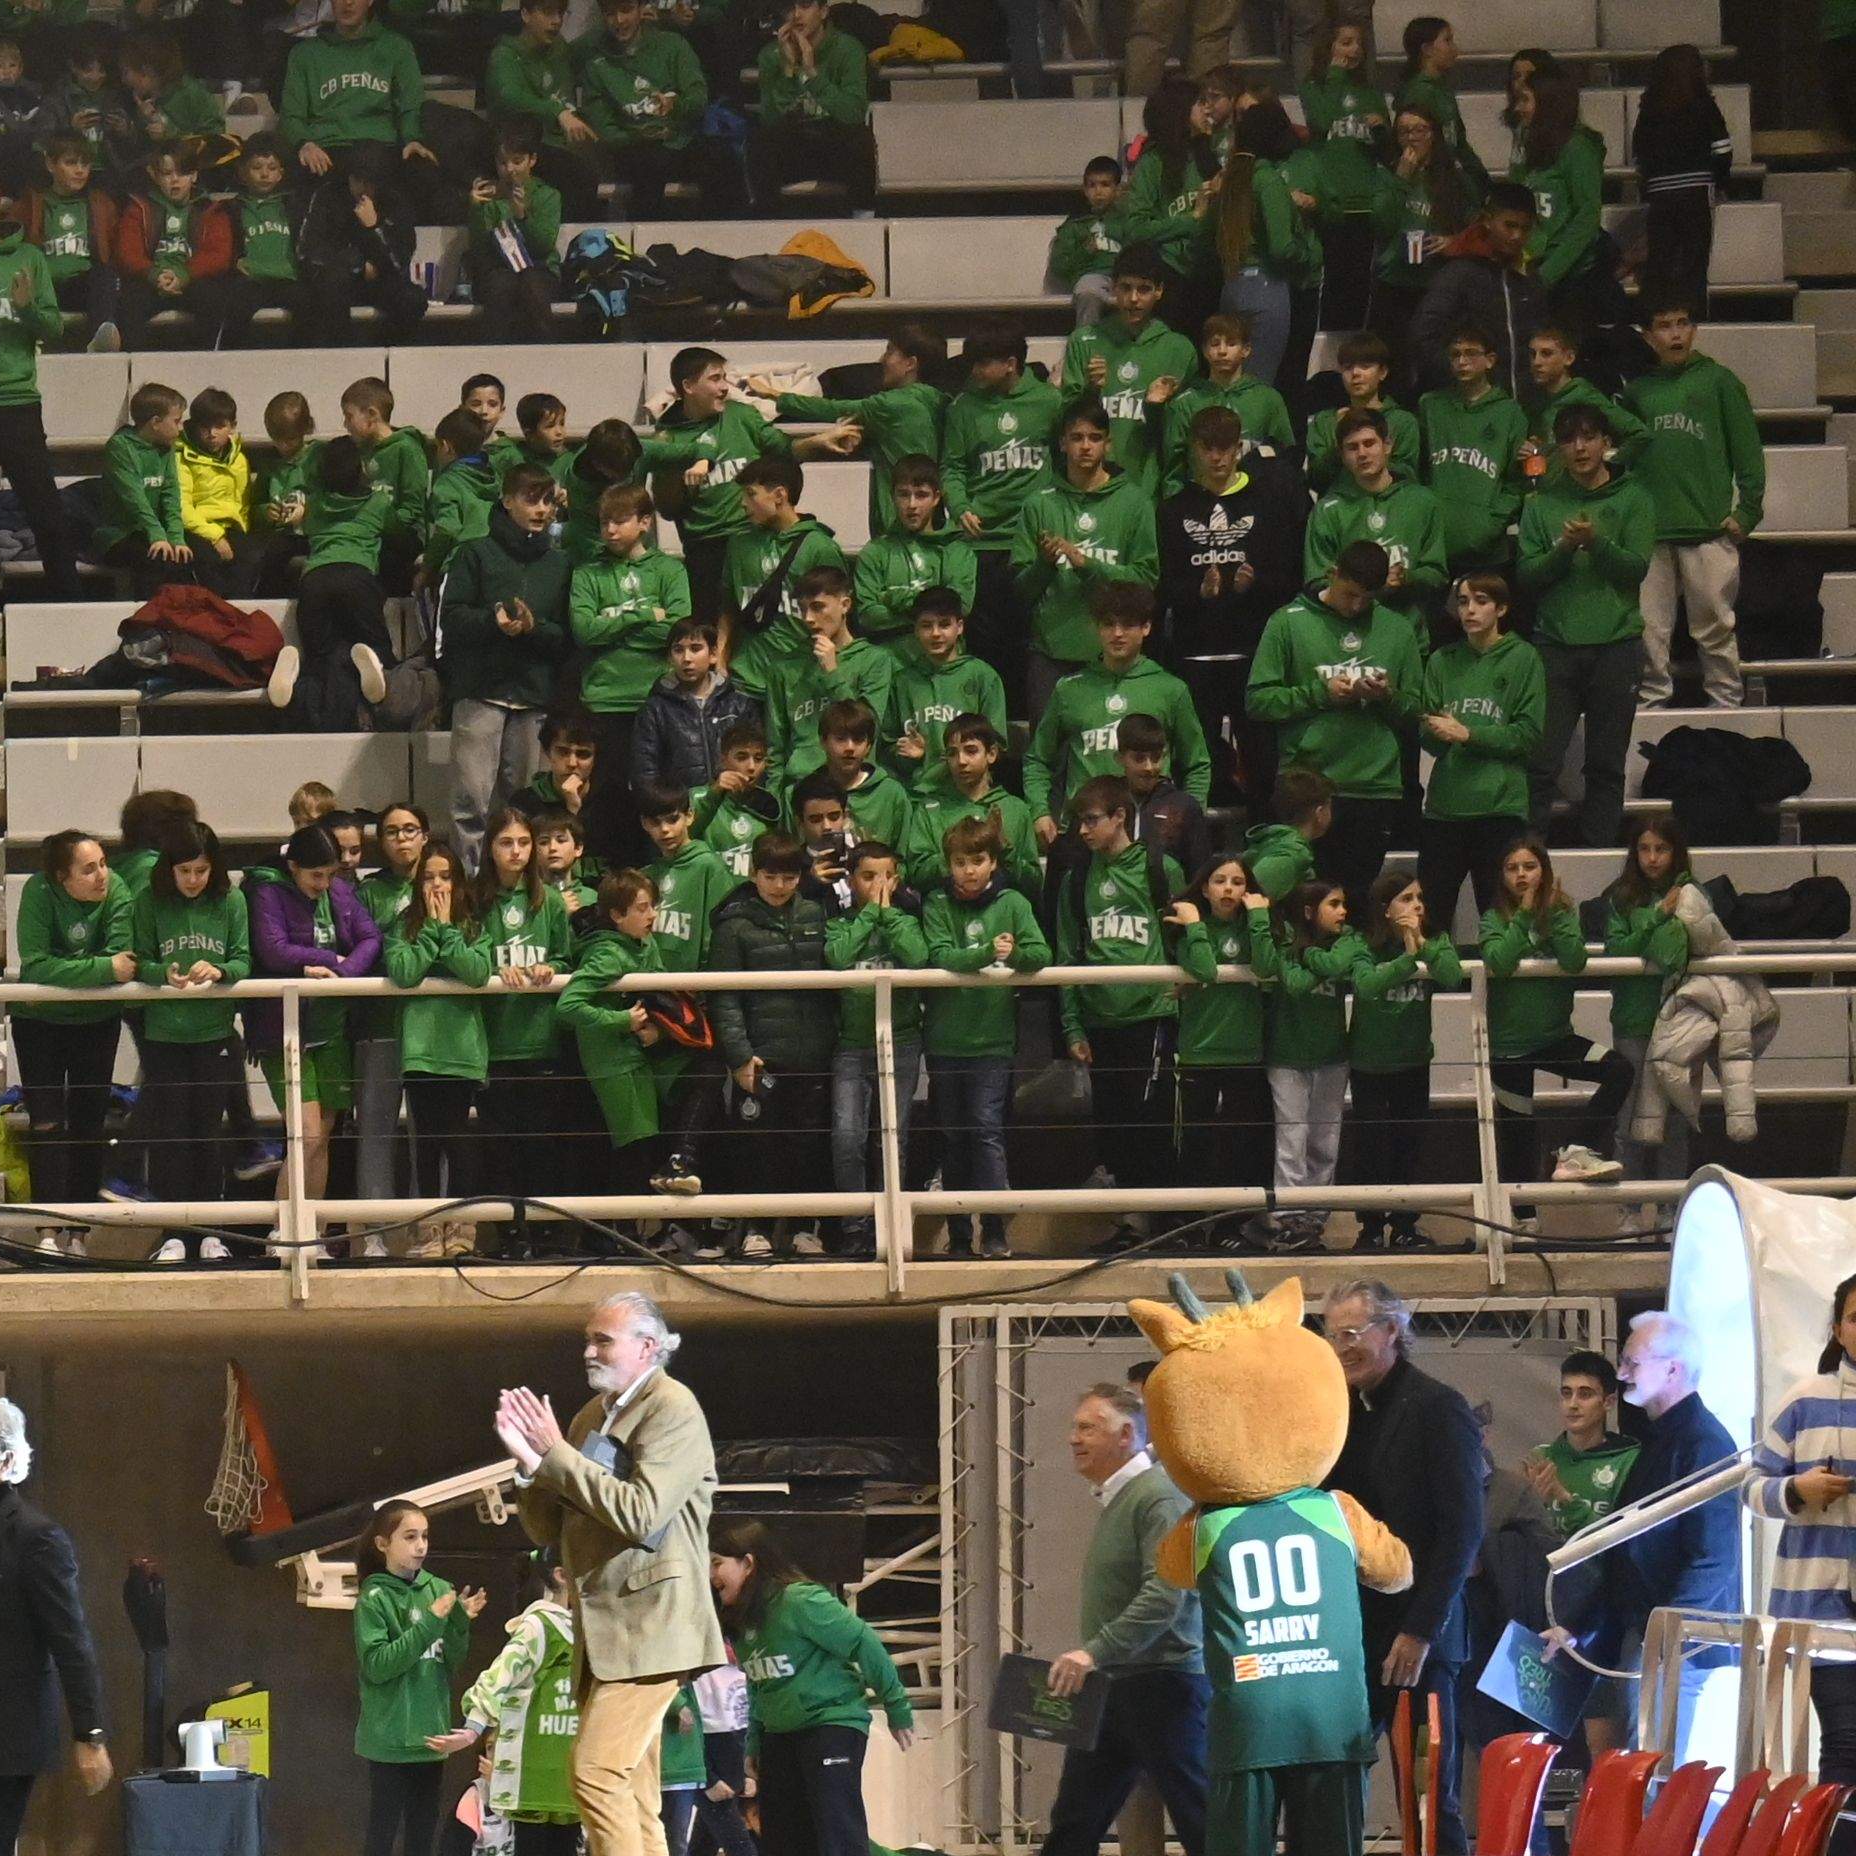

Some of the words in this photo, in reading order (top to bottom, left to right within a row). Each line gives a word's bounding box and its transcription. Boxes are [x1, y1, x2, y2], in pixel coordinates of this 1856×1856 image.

[1654, 411, 1705, 441] PEÑAS
[979, 437, 1044, 475] PEÑAS
[1451, 446, 1497, 480] PEÑAS
[1191, 550, 1247, 566] adidas
[178, 930, 225, 955] PEÑAS
[1229, 1533, 1321, 1612] 00
[1244, 1613, 1320, 1645] SARRY
[1258, 1648, 1329, 1667] GOBIERNO
[1259, 1663, 1279, 1678] DE
[538, 1714, 579, 1736] HUE
